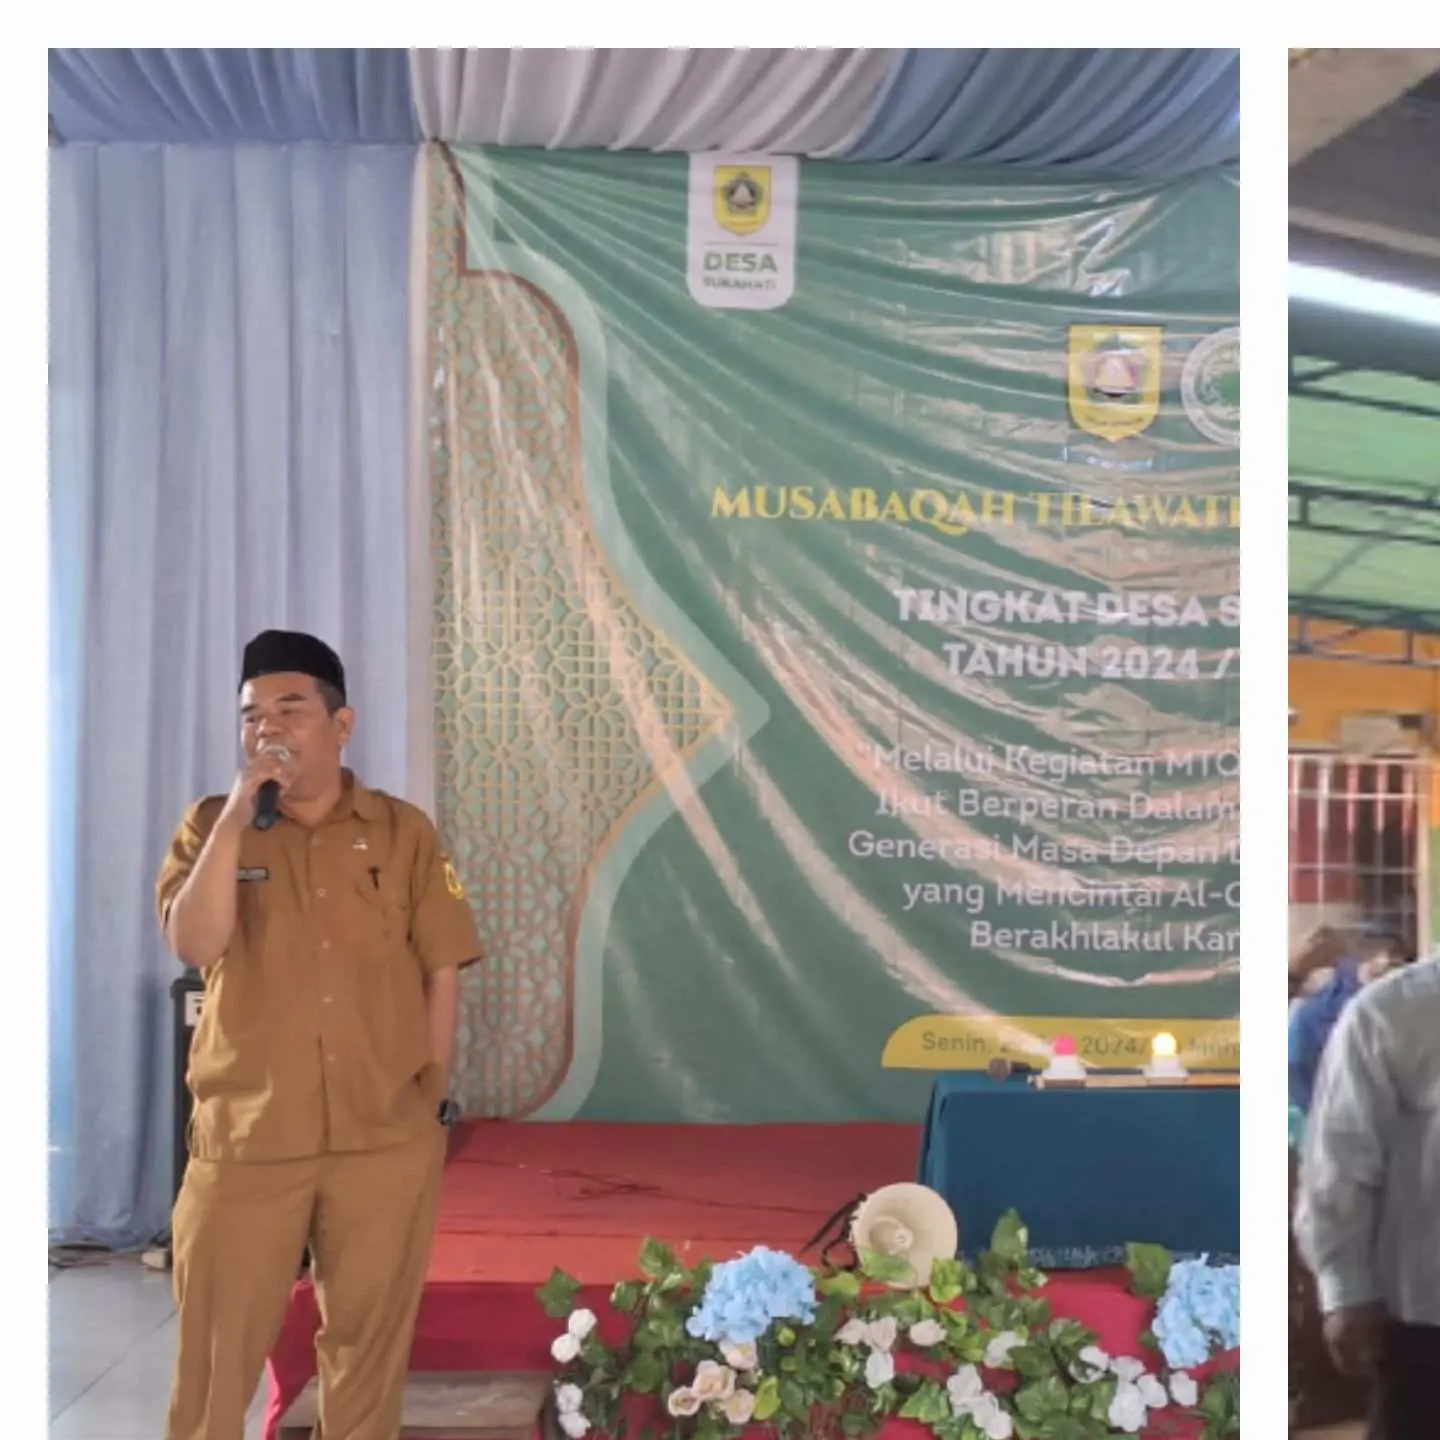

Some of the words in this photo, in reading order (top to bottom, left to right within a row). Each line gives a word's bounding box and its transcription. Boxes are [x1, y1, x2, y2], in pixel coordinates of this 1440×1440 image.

[704, 252, 777, 273] DESA
[711, 484, 1015, 537] MUSABAQAH
[893, 588, 1087, 626] TINGKAT
[1097, 593, 1208, 627] DESA
[943, 642, 1087, 679] TAHUN
[1100, 648, 1199, 680] 2024
[1005, 745, 1153, 781] Kegiatan
[875, 788, 949, 818] Ikut
[958, 788, 1119, 826] Berperan
[848, 830, 1001, 861] Generasi
[1012, 833, 1097, 864] Masa
[1110, 837, 1218, 873] Depan
[903, 880, 985, 914] yang
[996, 880, 1162, 907] Mencintai
[970, 921, 1174, 952] Berakhlakul
